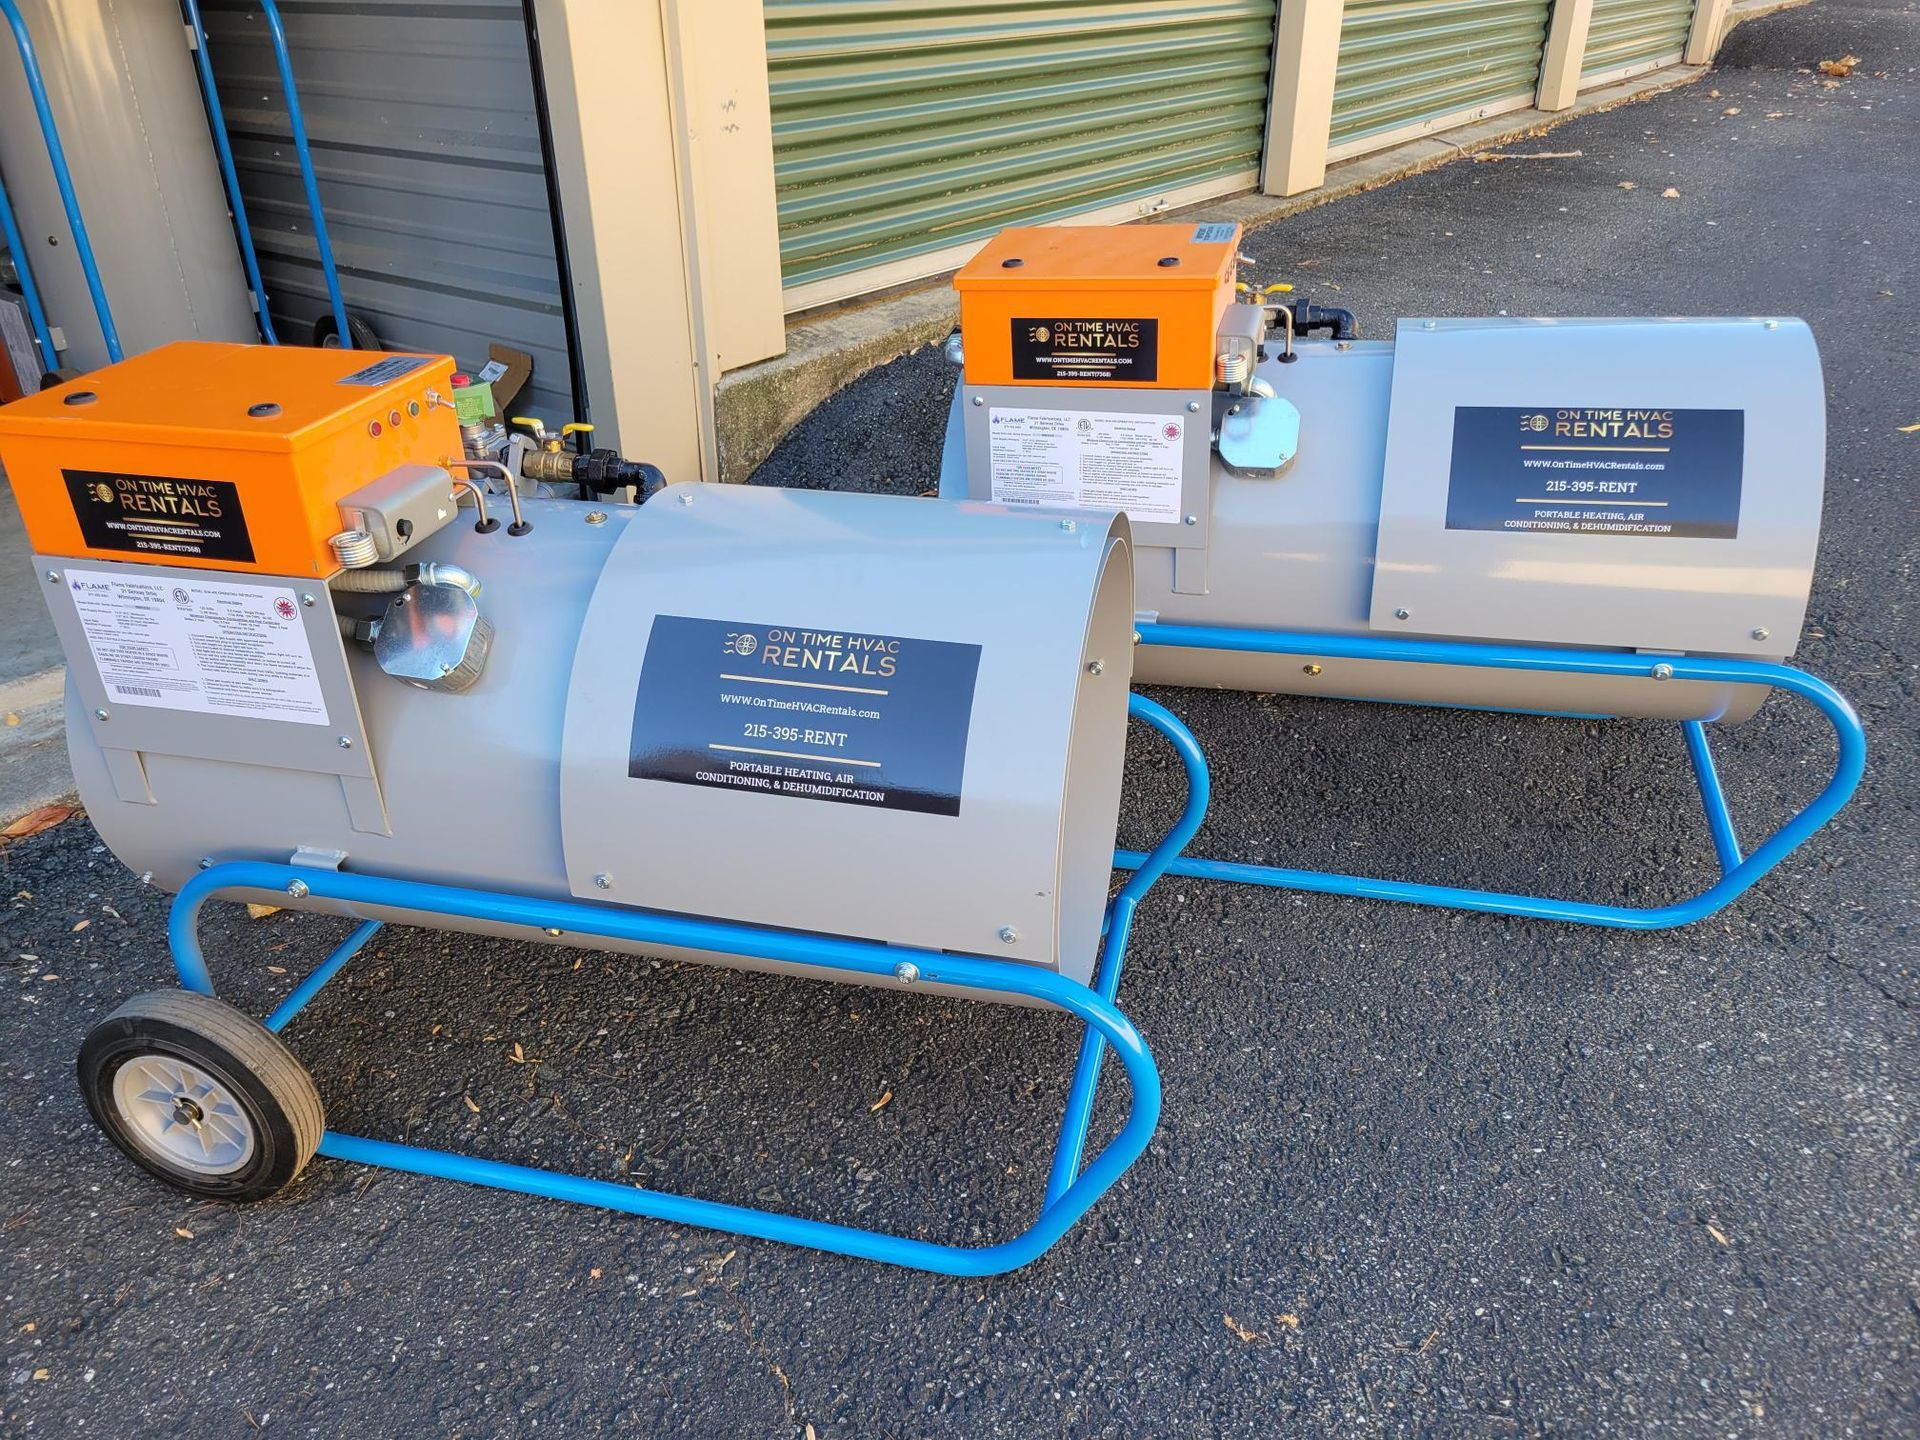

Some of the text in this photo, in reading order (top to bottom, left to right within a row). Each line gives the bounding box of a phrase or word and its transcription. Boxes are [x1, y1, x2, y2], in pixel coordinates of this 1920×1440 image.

[1054, 322, 1139, 332] ON TIME HVAC
[1054, 333, 1140, 348] RENTALS
[1036, 357, 1132, 365] WWW.ONTIMEHVACRENTALS.COM
[1000, 416, 1025, 424] FLAME
[1556, 410, 1673, 421] ON TIME HVAC
[1555, 422, 1674, 439] RENTALS
[115, 479, 218, 498] ON TIME HVAC
[1546, 480, 1638, 494] 215-395-RENT
[118, 493, 223, 518] RENTALS
[1534, 510, 1645, 521] PORTABLE HEATING, AIR
[105, 521, 221, 538] WWW.ONTIMEHVACRENTALS.COM
[1504, 520, 1672, 533] CONDITIONING, & DEHUMIDIFICATION
[80, 582, 110, 591] FLAME
[767, 629, 901, 654] ON TIME HVAC
[761, 645, 897, 677] RENTALS
[743, 723, 848, 747] 215-395-RENT
[729, 761, 854, 784] PORTABLE HEATING, AIR
[695, 771, 885, 802] CONDITIONING, & DEHUMIDIFICATION
